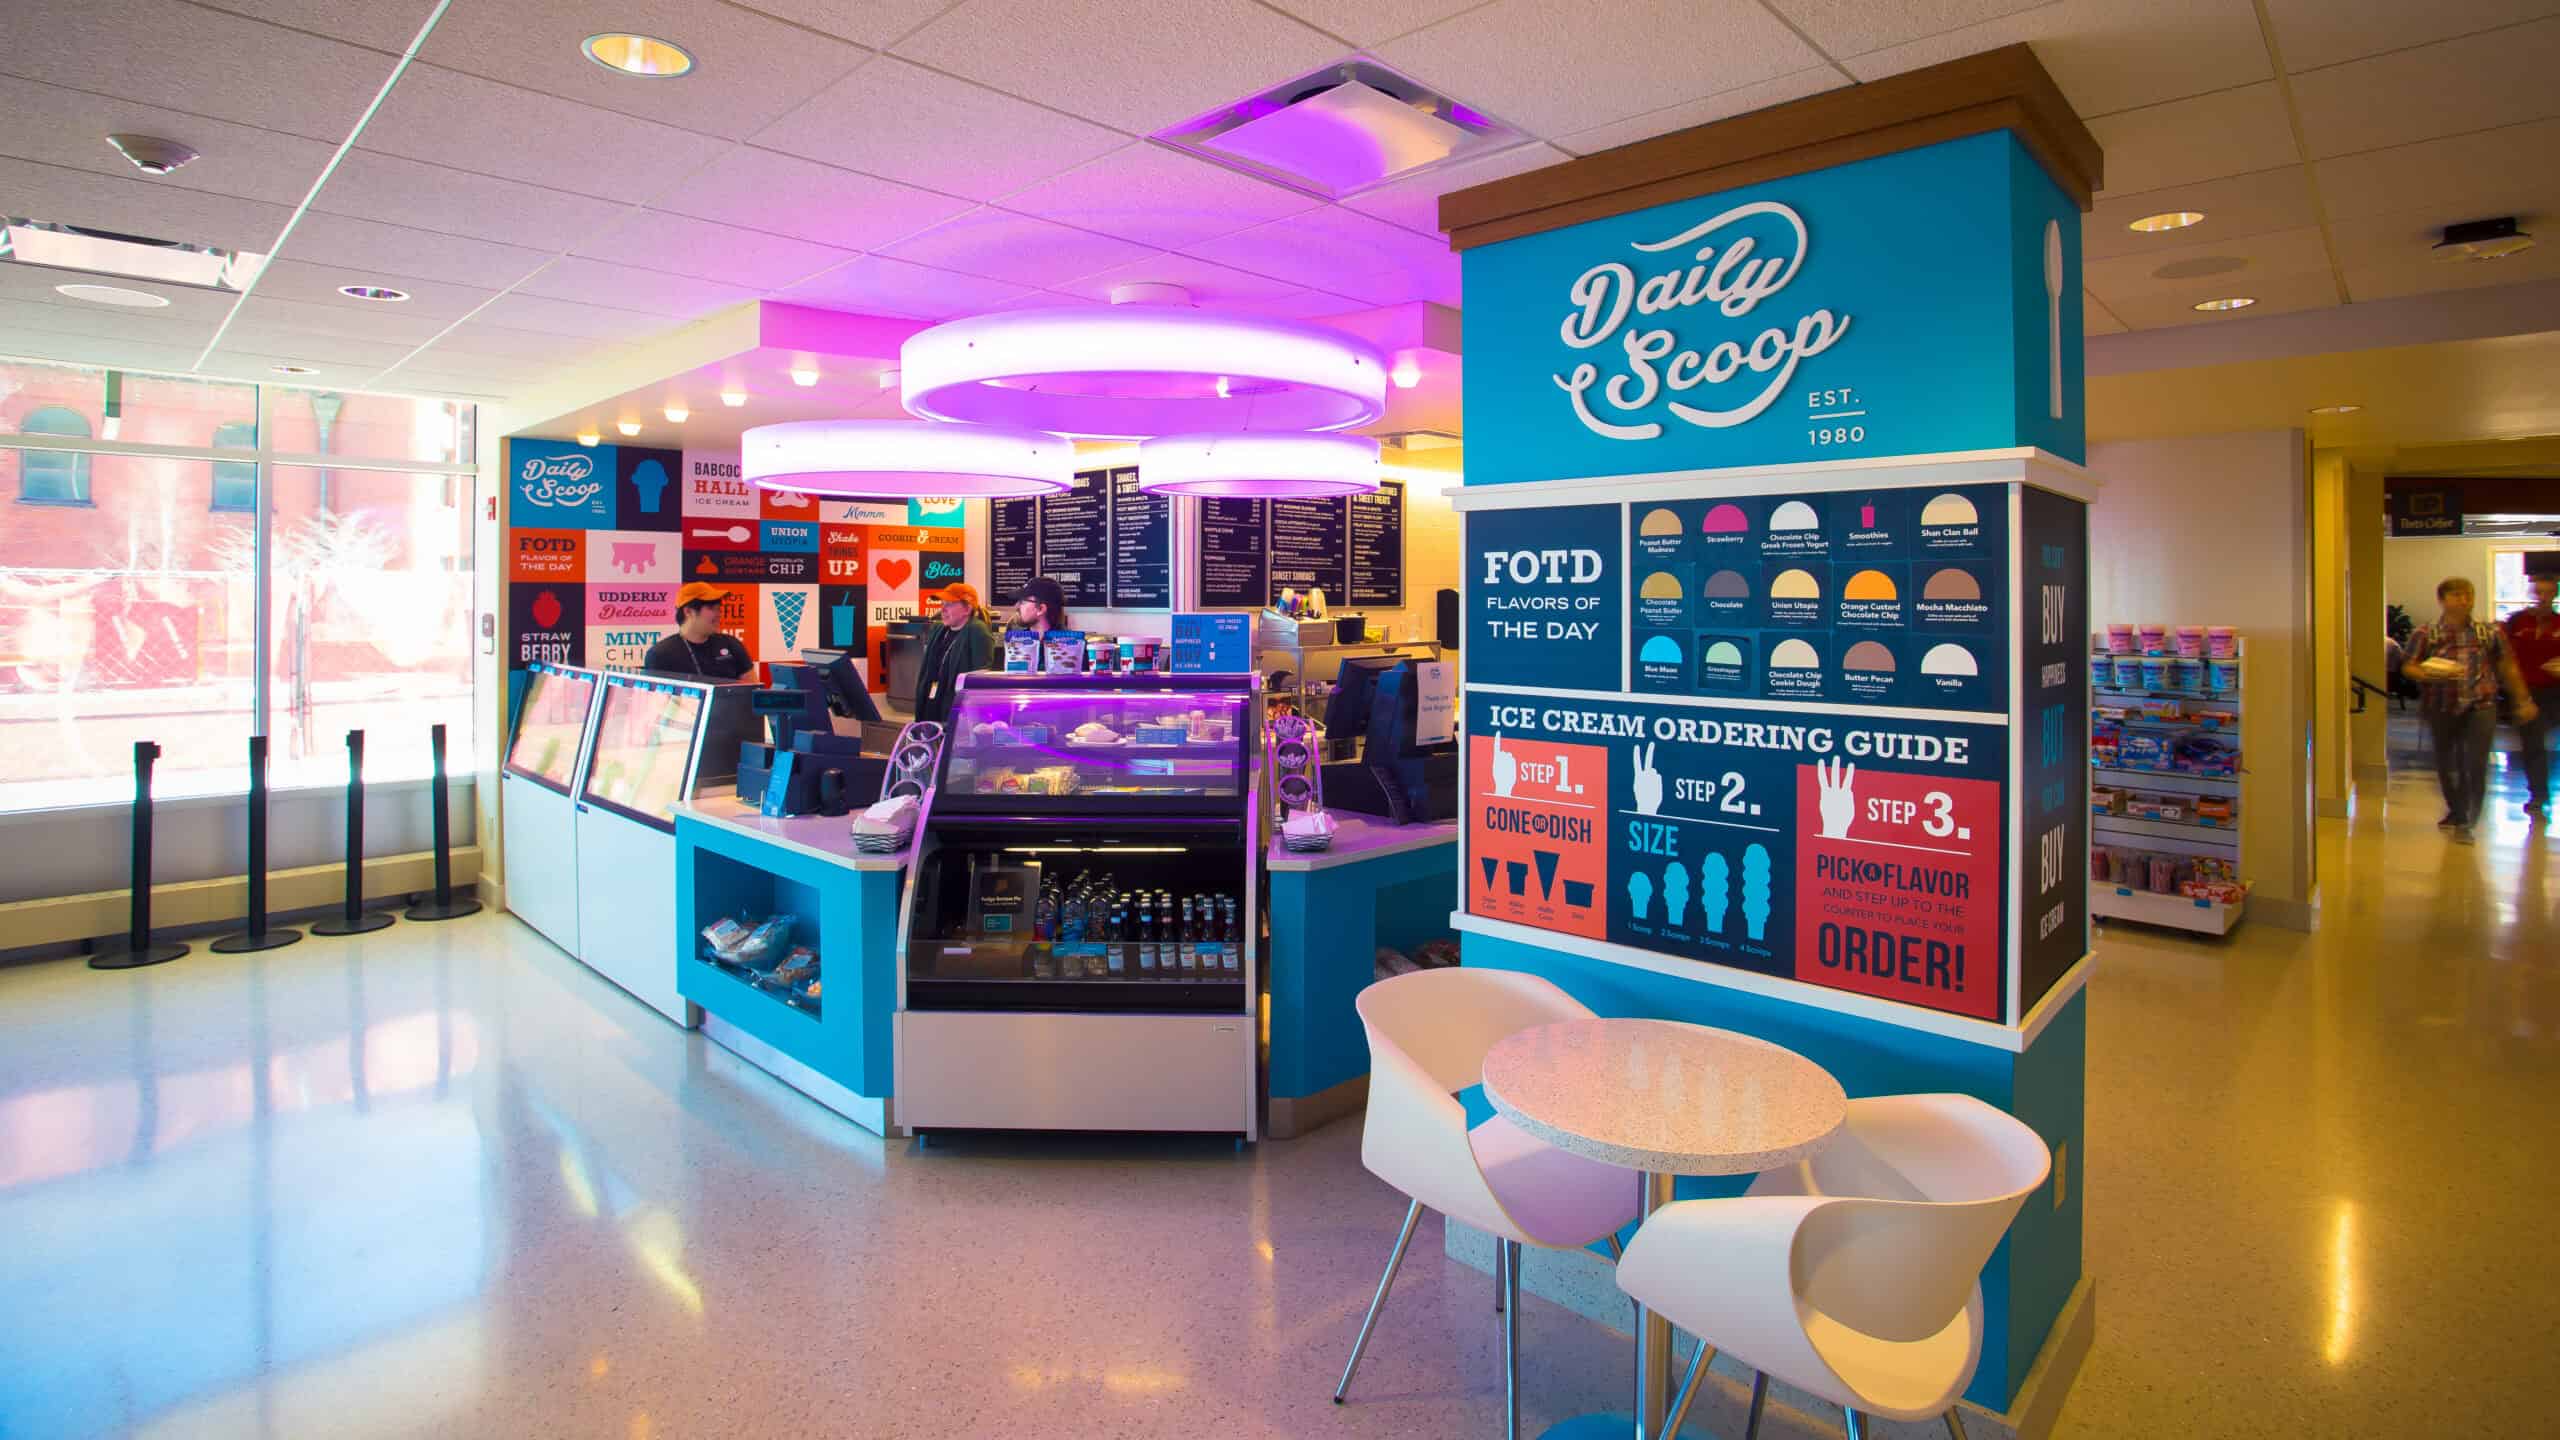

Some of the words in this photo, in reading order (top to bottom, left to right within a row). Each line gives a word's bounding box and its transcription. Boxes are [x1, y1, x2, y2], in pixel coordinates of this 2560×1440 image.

[1560, 205, 1806, 349] Daily
[1554, 309, 1850, 439] Scoop
[1808, 387, 1861, 408] EST.
[1808, 425, 1866, 446] 1980
[522, 454, 593, 481] Daily
[694, 462, 741, 478] BABCOC
[520, 477, 602, 507] Scoop
[694, 480, 749, 496] HALL
[771, 527, 808, 537] UNION
[828, 531, 859, 544] Shake
[1706, 536, 1744, 544] Strawberry
[1769, 534, 1802, 542] Chocolate
[1804, 533, 1820, 541] Chip
[1849, 532, 1889, 540] Smoothies
[520, 538, 576, 551] FOTD
[1761, 542, 1781, 550] Greek
[1807, 541, 1829, 549] Yogurt
[769, 563, 804, 574] CHIP
[828, 560, 859, 576] UP
[925, 561, 962, 578] Bliss
[1483, 549, 1603, 585] FOTD
[599, 592, 668, 602] UDDERLY
[1487, 597, 1569, 610] FLAVORS
[1574, 597, 1600, 610] OF
[1710, 601, 1743, 609] Chocolate
[598, 604, 667, 620] Delicious
[875, 607, 912, 620] DELISH
[1772, 601, 1793, 609] Union
[1795, 602, 1818, 610] Utopia
[1840, 603, 1869, 611] Orange
[1870, 603, 1901, 611] Custard
[1916, 603, 1943, 612] Mocha
[1945, 604, 1988, 612] Macchiato
[1841, 611, 1879, 619] Chocolate
[1881, 611, 1899, 620] Chip
[2042, 585, 2065, 644] BUY
[521, 632, 572, 641] STRAW
[605, 631, 661, 646] MINT
[1488, 621, 1538, 639] THE
[1546, 622, 1600, 640] DAY
[521, 643, 571, 664] BERRY
[1644, 665, 1658, 673] Blue
[1769, 671, 1804, 679] Chocolate
[1805, 672, 1822, 680] Chip
[1770, 679, 1795, 687] Cookie
[1796, 679, 1821, 688] Dough
[1845, 673, 1869, 682] Butter
[1871, 674, 1894, 683] Pecan
[1935, 679, 1963, 687] Vanilla
[1490, 705, 1535, 729] ICE
[1542, 709, 1646, 738] CREAM
[1654, 717, 1833, 753] ORDERING
[1845, 730, 1969, 765] GUIDE
[1520, 762, 1554, 784] STEP
[1555, 755, 1585, 794] 1.
[1675, 778, 1716, 803] STEP
[1720, 771, 1761, 815] 2.
[1867, 797, 1916, 825] STEP
[1922, 791, 1970, 840] 3.
[1487, 806, 1531, 835] CONE
[1549, 819, 1592, 844] DISH
[1628, 820, 1679, 857] SIZE
[2041, 823, 2065, 894] BUY
[1817, 854, 1864, 884] PICK
[1883, 863, 1969, 900] FLAVOR
[1823, 887, 1851, 900] AND
[1855, 891, 1888, 905] STEP
[1891, 895, 1909, 909] UP
[1913, 899, 1932, 913] TO
[1937, 903, 1965, 918] THE
[1823, 904, 1874, 921] COUNTER
[1877, 912, 1892, 923] TO
[1894, 916, 1929, 929] PLACE
[1818, 921, 1965, 993] ORDER!
